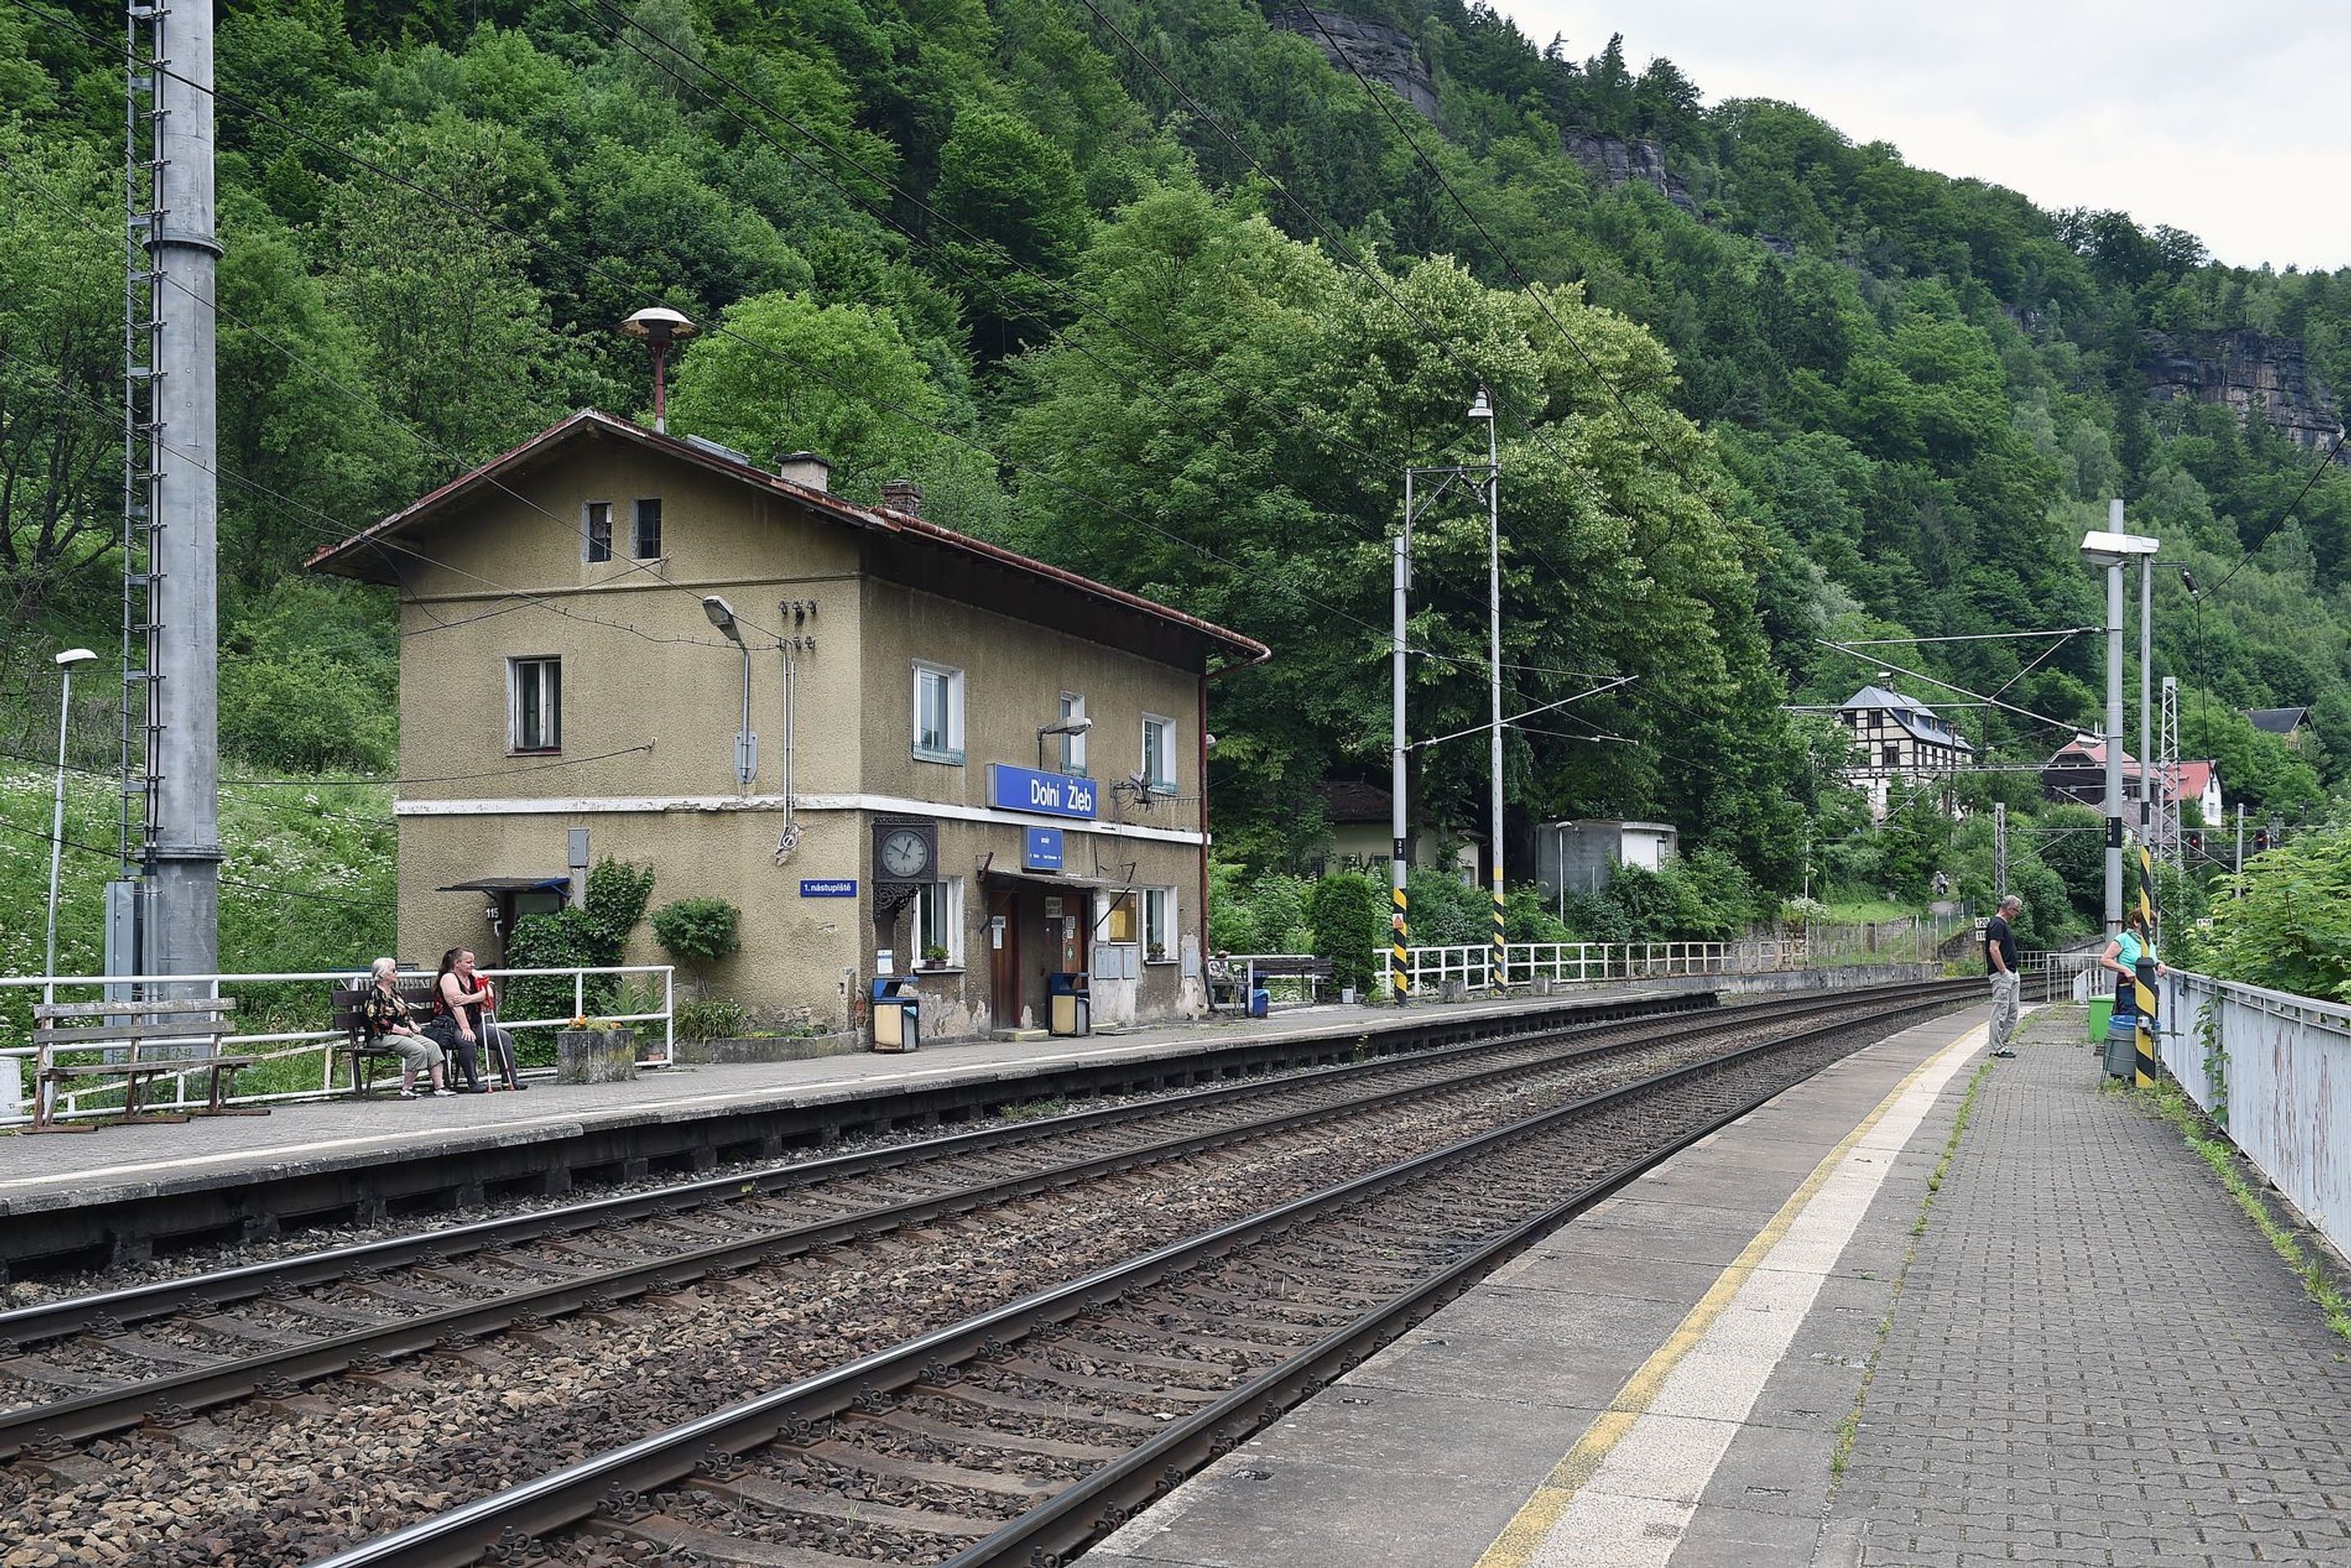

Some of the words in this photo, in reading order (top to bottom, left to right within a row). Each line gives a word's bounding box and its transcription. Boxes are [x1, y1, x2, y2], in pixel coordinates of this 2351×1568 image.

[1067, 779, 1092, 812] Žleb
[810, 882, 852, 893] nástupiště
[486, 907, 499, 918] 115
